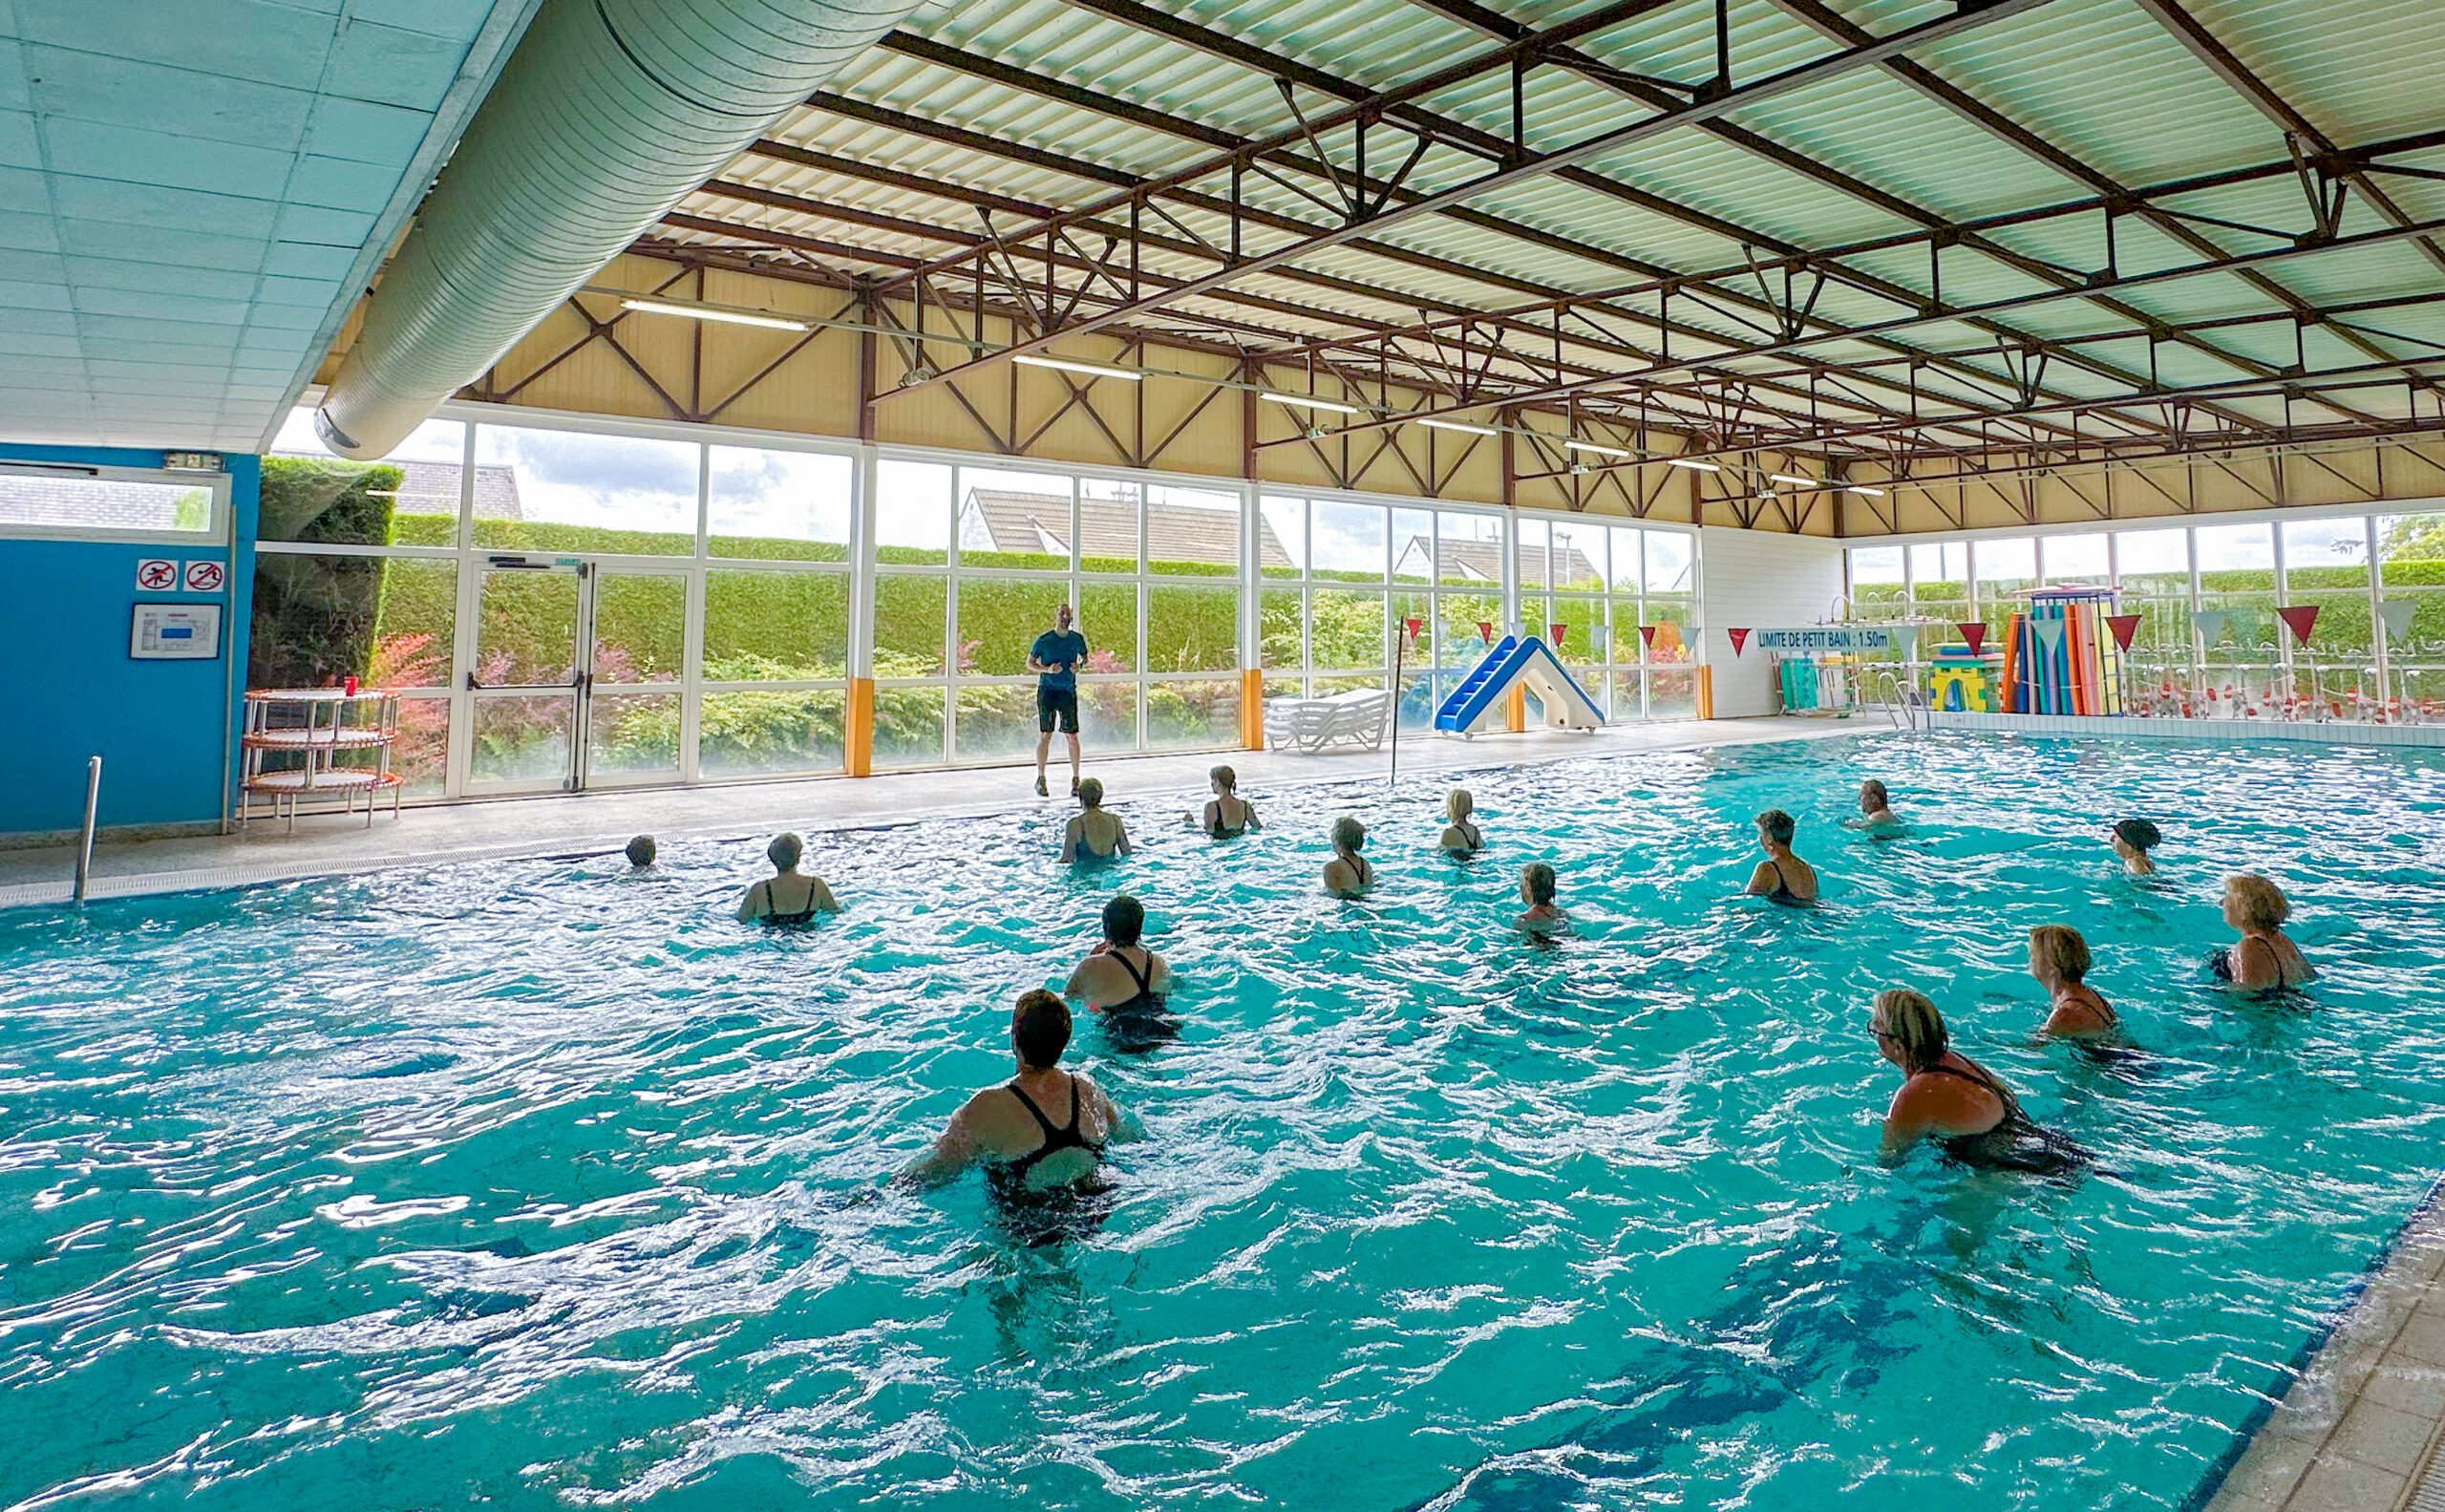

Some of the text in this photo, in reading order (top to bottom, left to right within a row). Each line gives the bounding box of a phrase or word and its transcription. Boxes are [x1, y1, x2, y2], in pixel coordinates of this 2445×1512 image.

[1758, 632, 1786, 648] LIMITE
[1788, 632, 1800, 647] DE
[1802, 632, 1825, 647] PETIT
[1828, 631, 1850, 647] BAIN
[1859, 631, 1887, 647] 1.50m
